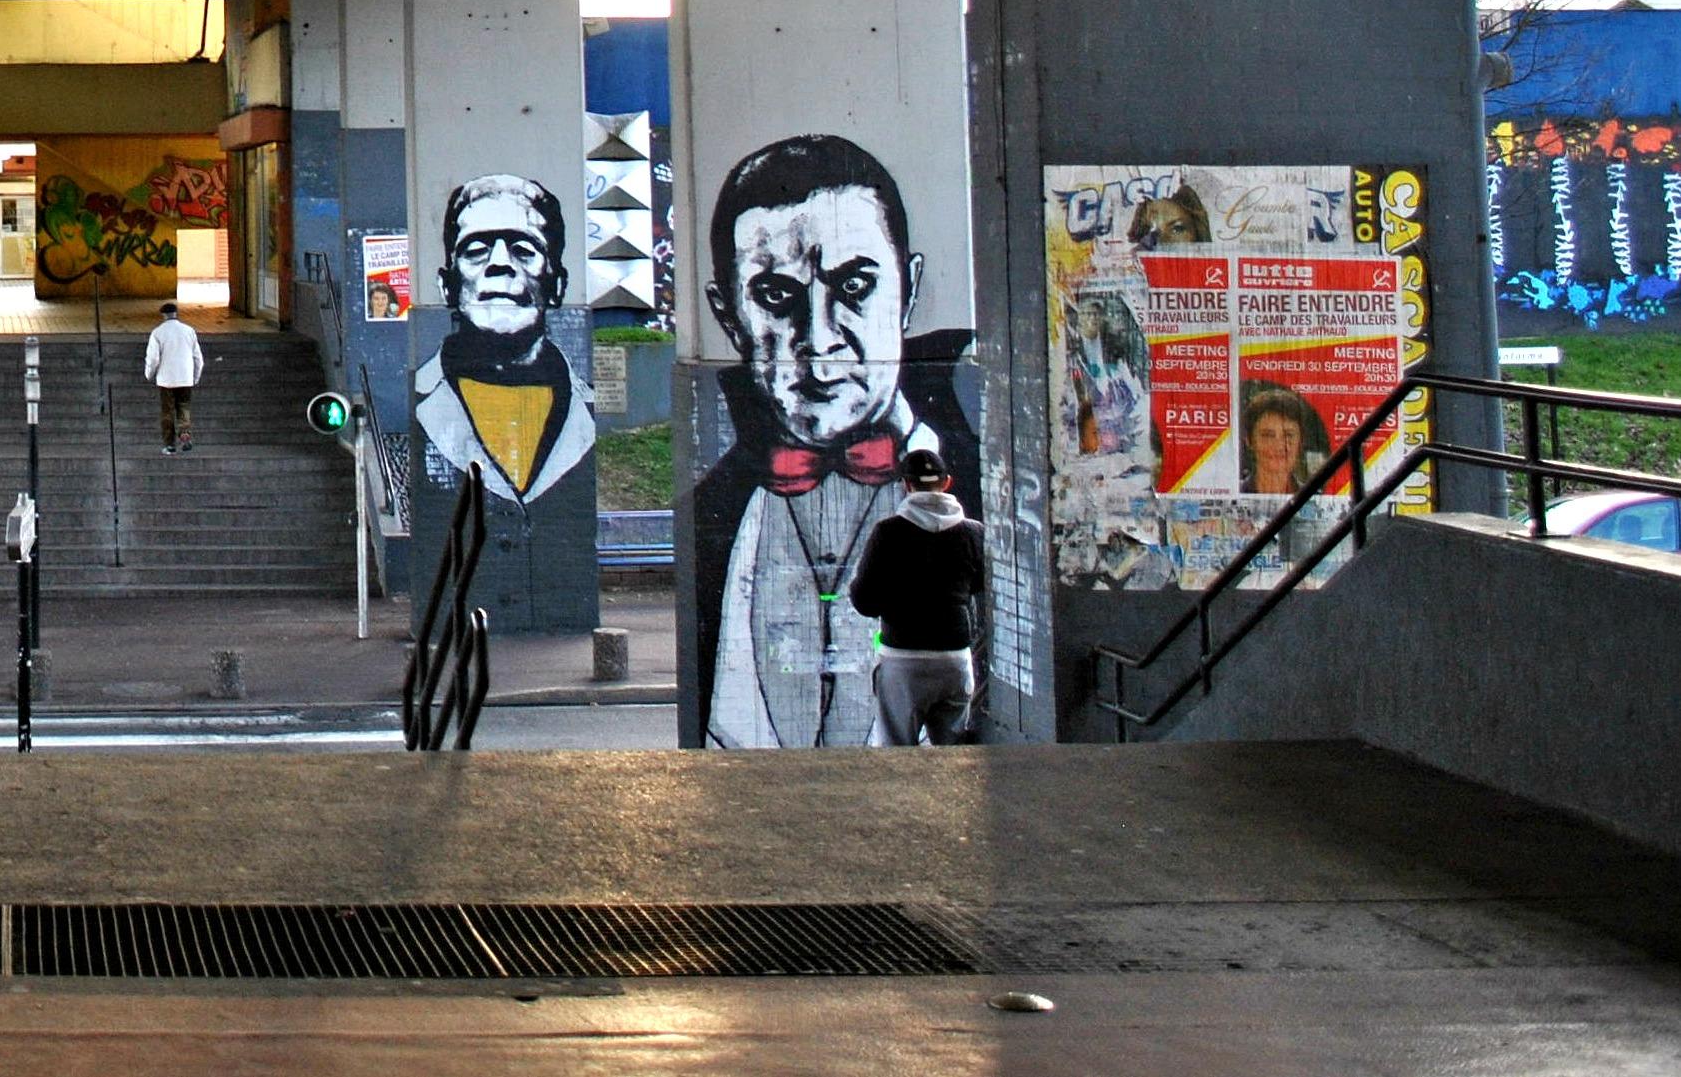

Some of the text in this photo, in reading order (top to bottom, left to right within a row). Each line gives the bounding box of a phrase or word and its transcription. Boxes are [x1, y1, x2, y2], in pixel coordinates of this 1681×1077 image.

[1355, 170, 1373, 242] AUTO
[1242, 264, 1313, 277] lutte
[1148, 292, 1228, 309] TENDRE
[1238, 294, 1396, 312] FAIRE ENTENDRE
[1148, 311, 1229, 323] TRAVAILLEURS
[1238, 314, 1397, 326] LE CAMP DES TRAVAILLEURS
[1239, 327, 1261, 336] AVEC
[1165, 345, 1227, 356] MEETING
[1334, 347, 1396, 359] MEETING
[1156, 359, 1227, 371] SEPTEMBRE
[1246, 361, 1396, 373] VENDREDI 30 SEPTEMBRE
[1196, 371, 1227, 380] 20h30
[1364, 373, 1396, 382] 20h30
[1166, 410, 1229, 424] PARIS
[1334, 412, 1397, 427] PAS
